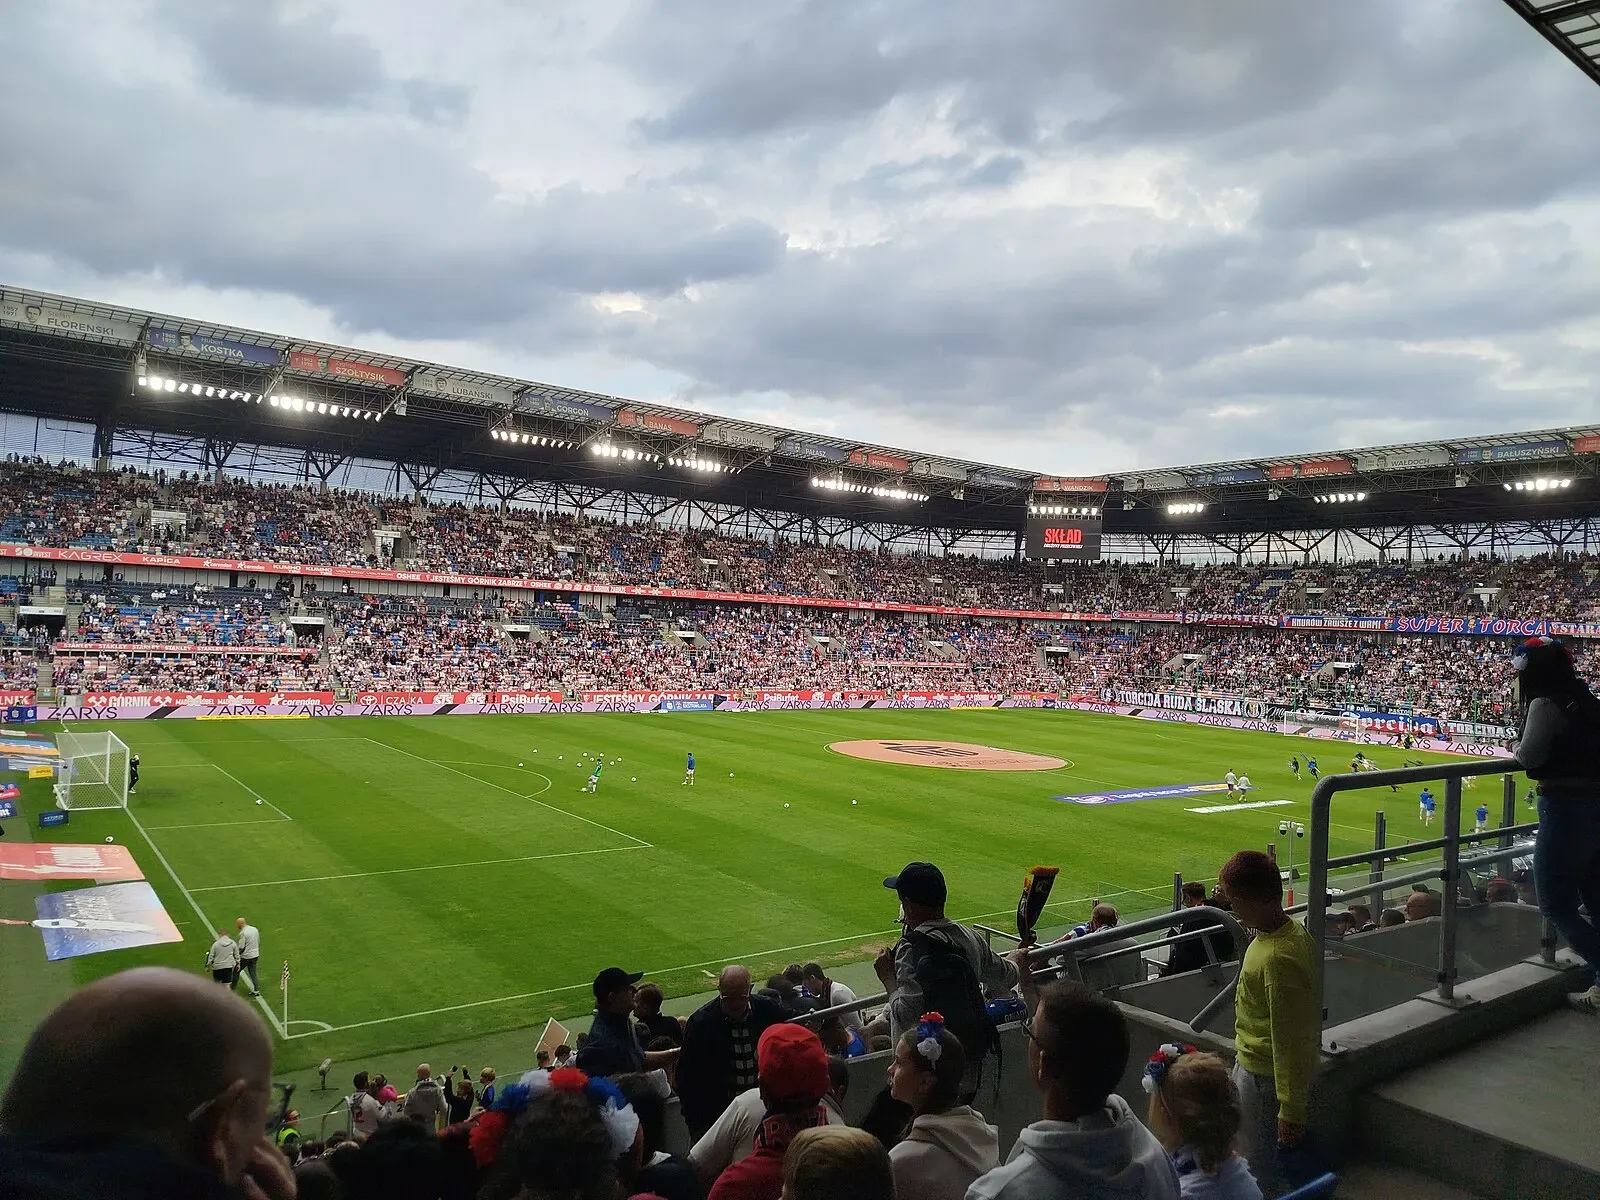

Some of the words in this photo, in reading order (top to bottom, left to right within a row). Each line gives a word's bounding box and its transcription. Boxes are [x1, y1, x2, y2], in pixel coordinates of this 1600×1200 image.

[47, 318, 114, 337] FLORENSKI
[201, 344, 244, 359] KOSTKA
[335, 366, 385, 382] SZOŁTYSIK
[452, 387, 493, 400] LUBAŃSKI
[1497, 446, 1559, 459] BAŁUSZYŃSKI
[1391, 458, 1430, 467] WAŁDOCH
[1304, 467, 1329, 476] URBAN
[1044, 528, 1082, 544] SKŁAD
[58, 550, 124, 563] KAGREX
[396, 573, 421, 581] OSHEE
[430, 575, 465, 585] JESTEŚMY
[467, 576, 497, 587] GÓRNIK
[497, 579, 524, 588] ZABRZE
[1185, 613, 1279, 627] SUPPORTERS
[1323, 619, 1353, 628] ZAWSZE
[1359, 620, 1382, 629] WAMI
[1397, 617, 1464, 632] SUPER
[1479, 619, 1547, 636] TORCA
[108, 694, 153, 707] GÓRNIK
[281, 697, 321, 705] corendon
[501, 693, 553, 704] PsiBufet
[763, 693, 799, 702] PsiBufet
[1120, 690, 1162, 708] TORCIDA
[1163, 694, 1193, 711] RUDA
[287, 704, 344, 716] ZARYS
[360, 704, 413, 716] ZARYS
[479, 703, 525, 714] ZARYS
[539, 703, 583, 713] ZARYS
[595, 702, 636, 712] ZARYS
[736, 701, 770, 710] ZARYS
[780, 700, 812, 709] ZARYS
[820, 700, 851, 709] ZARYS
[887, 700, 916, 708] ZARYS
[924, 700, 950, 708] ZARYS
[1013, 700, 1037, 708] ZARYS
[1055, 702, 1080, 710] ARYS
[1088, 703, 1117, 714] ZARYS
[47, 706, 118, 720] ZARYS
[206, 705, 267, 716] ZARYS
[1155, 710, 1187, 722] ZARYS
[1197, 715, 1232, 727] ZARYS
[1241, 719, 1278, 732] ZARYS
[1448, 721, 1505, 738] TORCIDA
[1446, 742, 1495, 756] ZARYS
